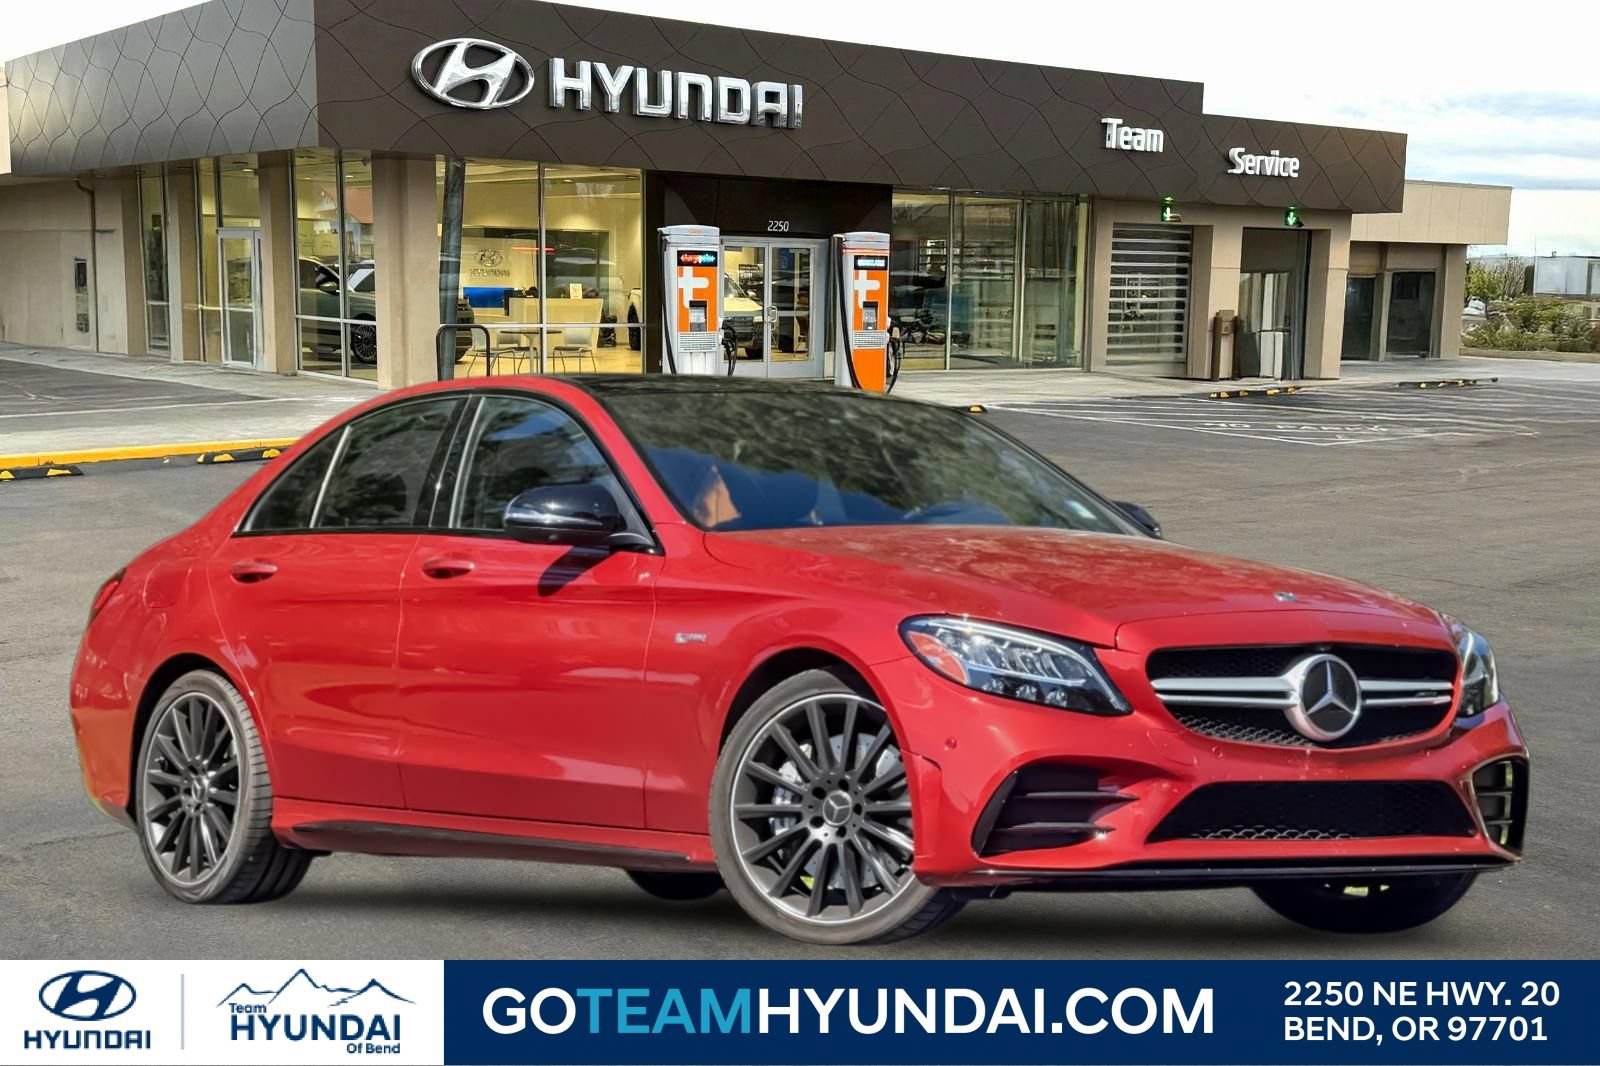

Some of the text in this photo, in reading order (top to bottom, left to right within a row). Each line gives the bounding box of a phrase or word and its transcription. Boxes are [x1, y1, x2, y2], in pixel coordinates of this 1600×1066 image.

[549, 57, 803, 128] HYUNDAI
[1101, 117, 1164, 152] Team
[1227, 147, 1299, 177] Service
[767, 220, 790, 232] 2250
